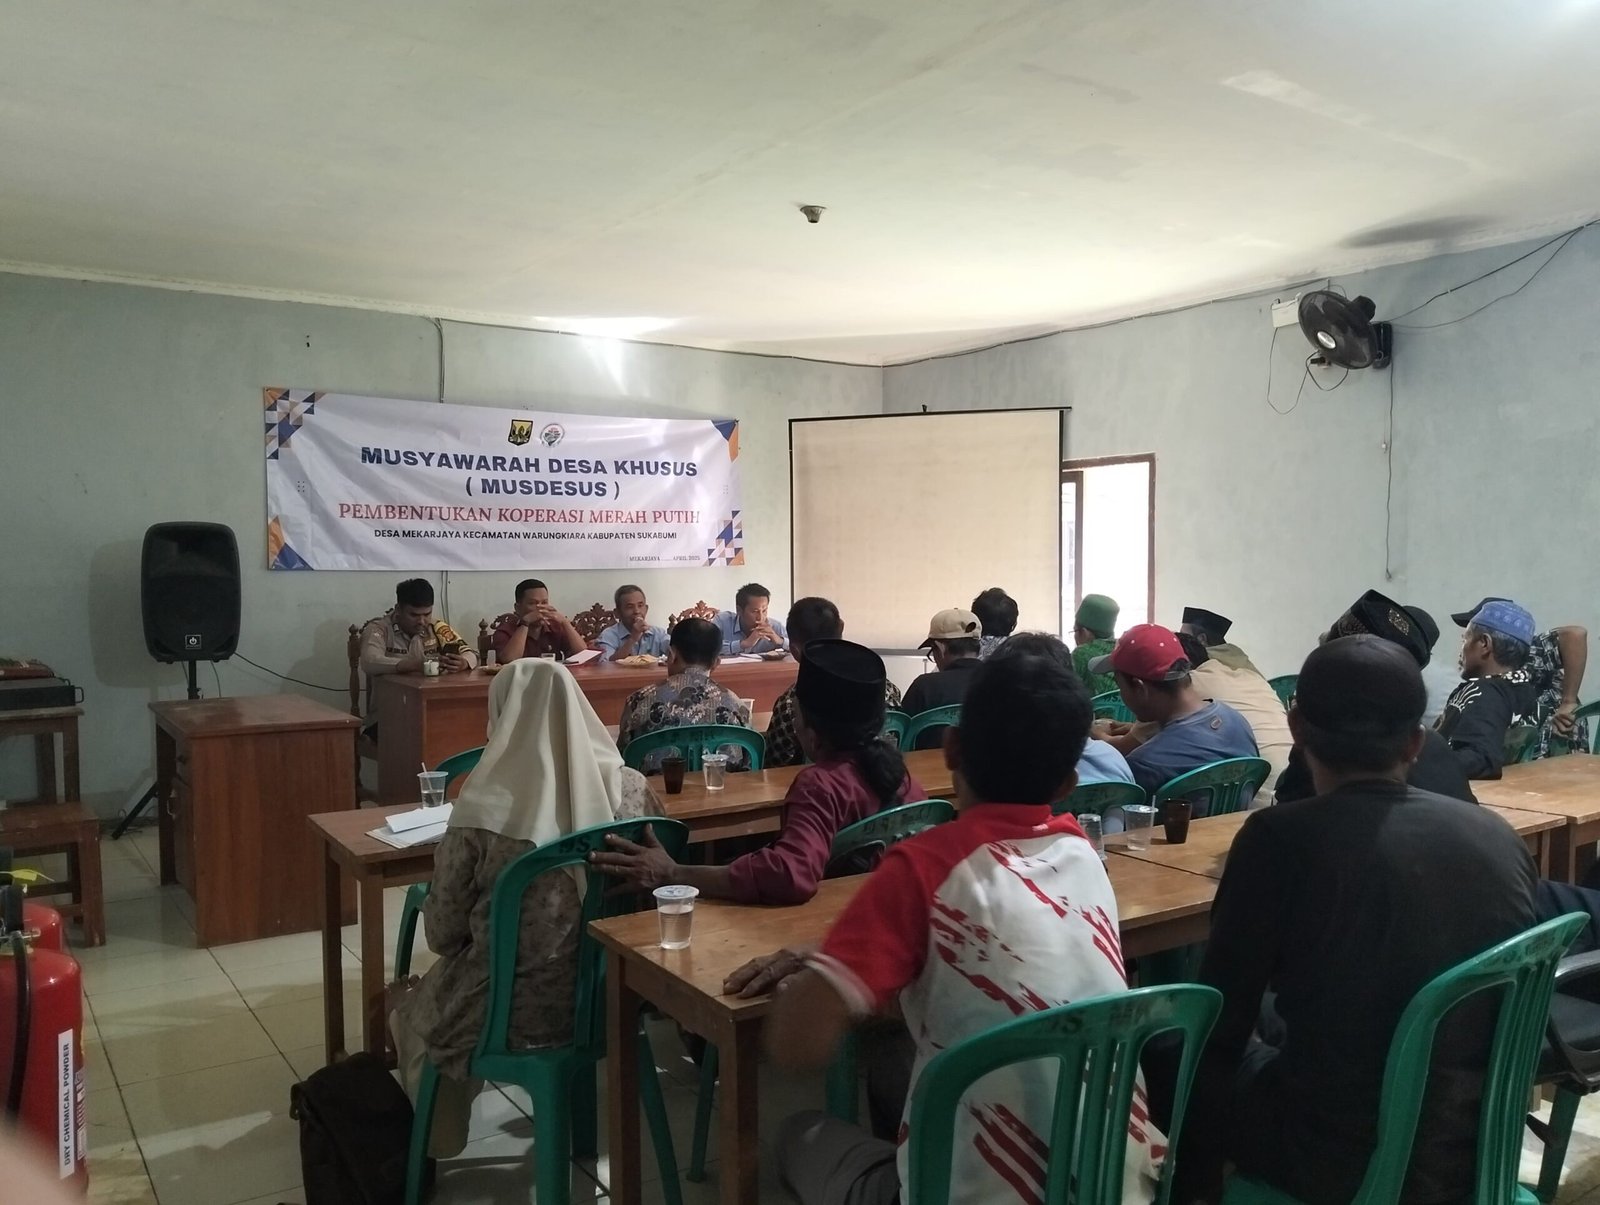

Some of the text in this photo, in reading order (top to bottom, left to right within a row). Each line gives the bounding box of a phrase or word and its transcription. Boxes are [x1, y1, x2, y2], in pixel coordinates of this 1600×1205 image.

[361, 446, 698, 477] MUSYAWARAH DESA KHUSUS
[481, 478, 607, 497] MUSDESUS
[339, 503, 701, 524] PEMBENTUKAN KOPERASI MERAH PUTIH
[374, 529, 401, 538] DESA
[402, 530, 462, 539] MEKARJAYA
[463, 531, 521, 539] KECAMATAN
[522, 532, 586, 540] WARUNGKIARA
[587, 532, 636, 540] KABUPATEN
[63, 1090, 71, 1143] CHEMICAL
